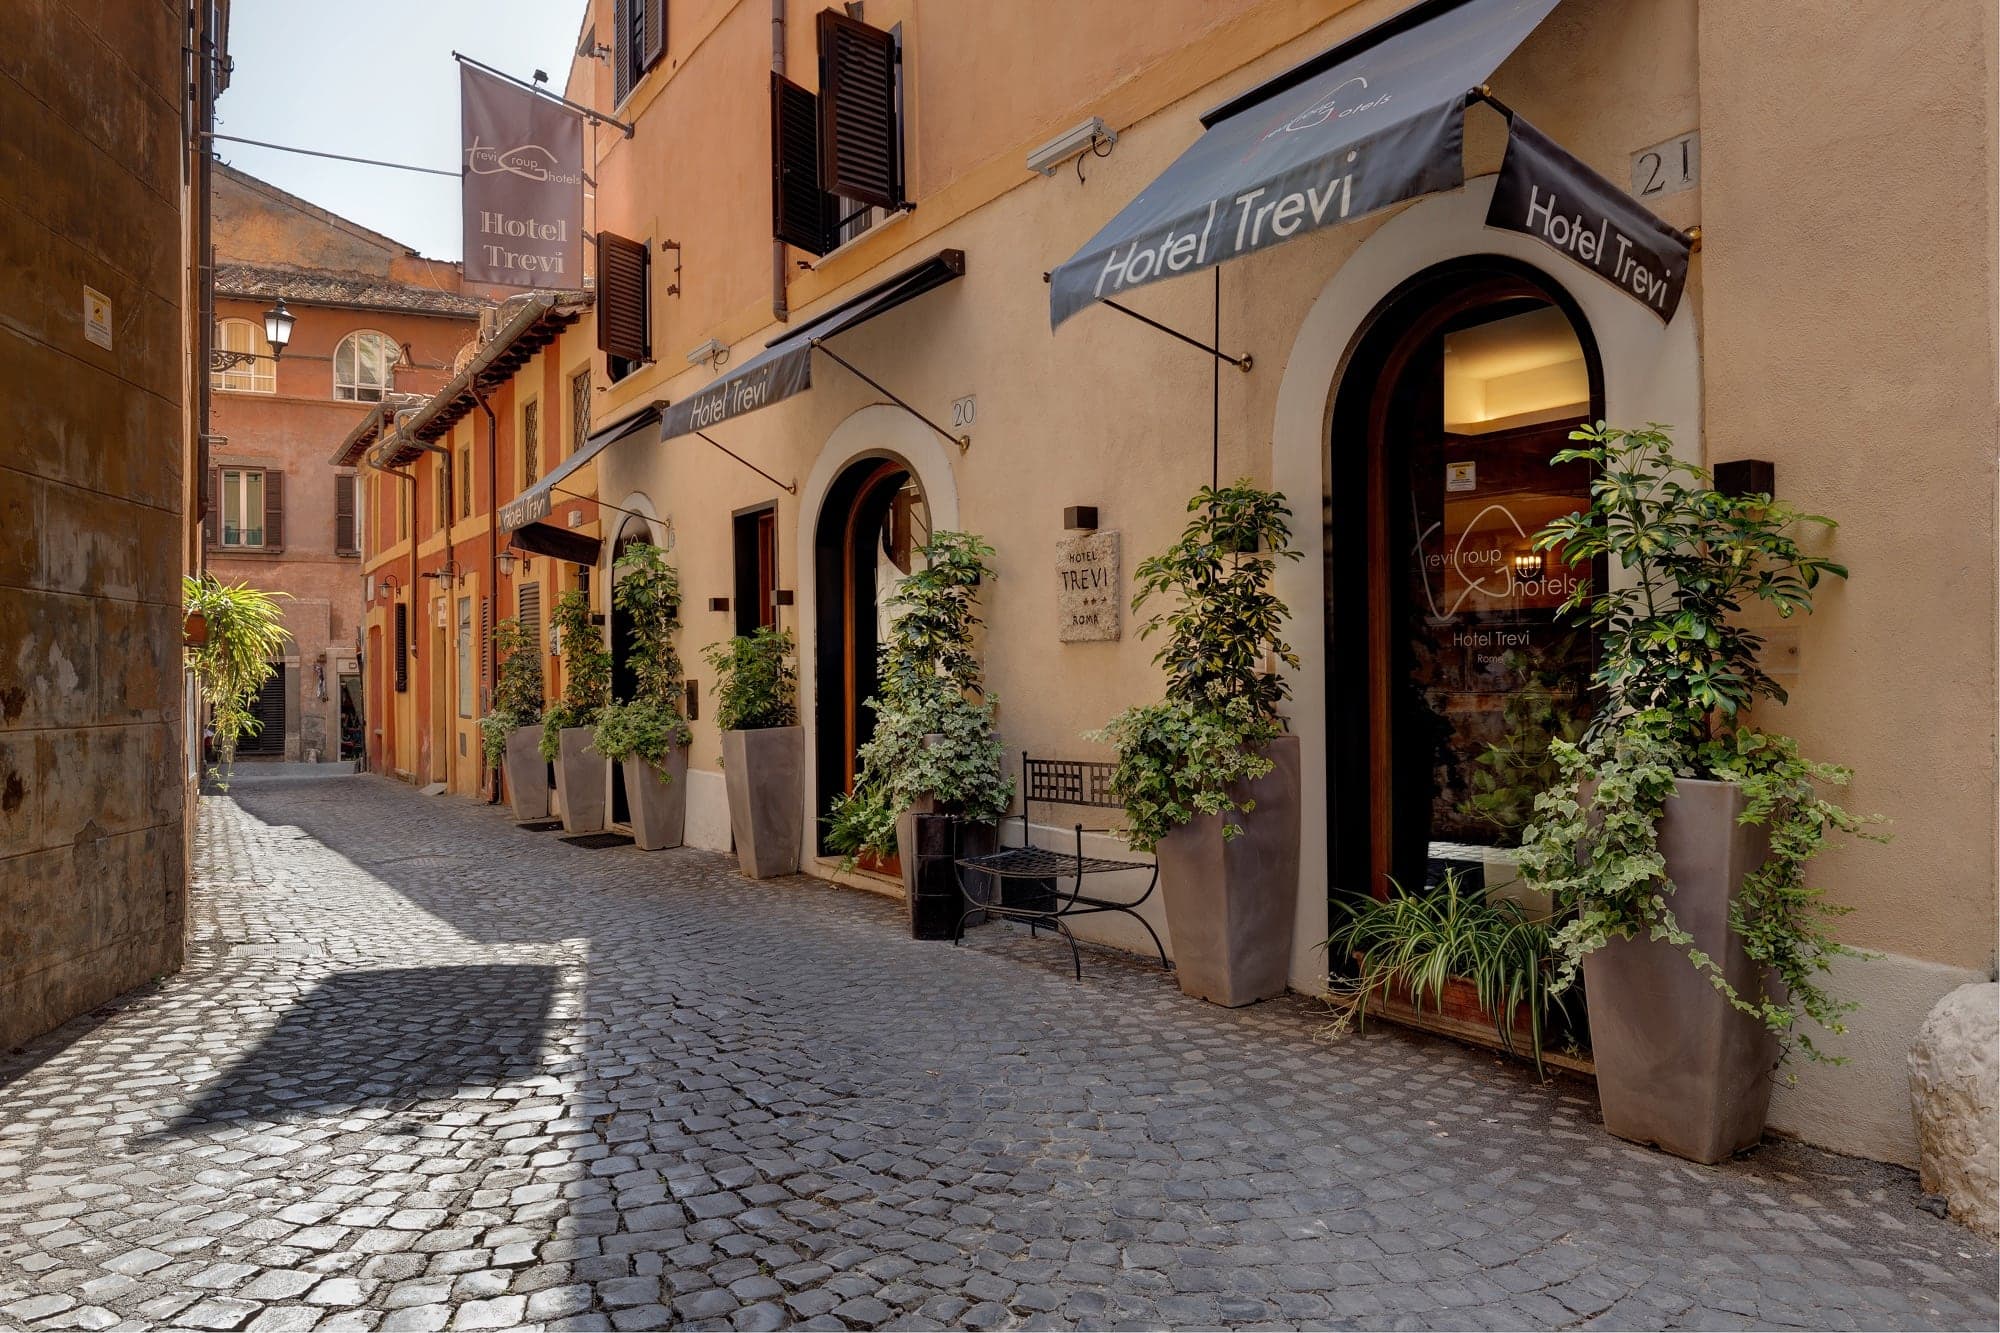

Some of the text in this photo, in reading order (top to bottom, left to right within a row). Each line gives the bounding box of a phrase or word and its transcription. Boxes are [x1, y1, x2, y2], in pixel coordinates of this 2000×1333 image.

[548, 170, 581, 185] hotels
[1638, 139, 1693, 197] 21
[480, 210, 568, 242] Hotel
[1094, 150, 1357, 298] Hotel Trevi
[483, 244, 565, 274] Trevi
[1525, 184, 1673, 308] Hotel Trevi
[689, 368, 767, 430] Hotel Trevi
[953, 399, 975, 428] 20
[503, 497, 527, 529] Hotel
[1069, 551, 1098, 563] HOTEL
[1062, 567, 1108, 591] TREVI
[1511, 572, 1578, 598] hotels
[1073, 614, 1099, 625] ROMA
[1453, 629, 1530, 646] Hotel Trevi
